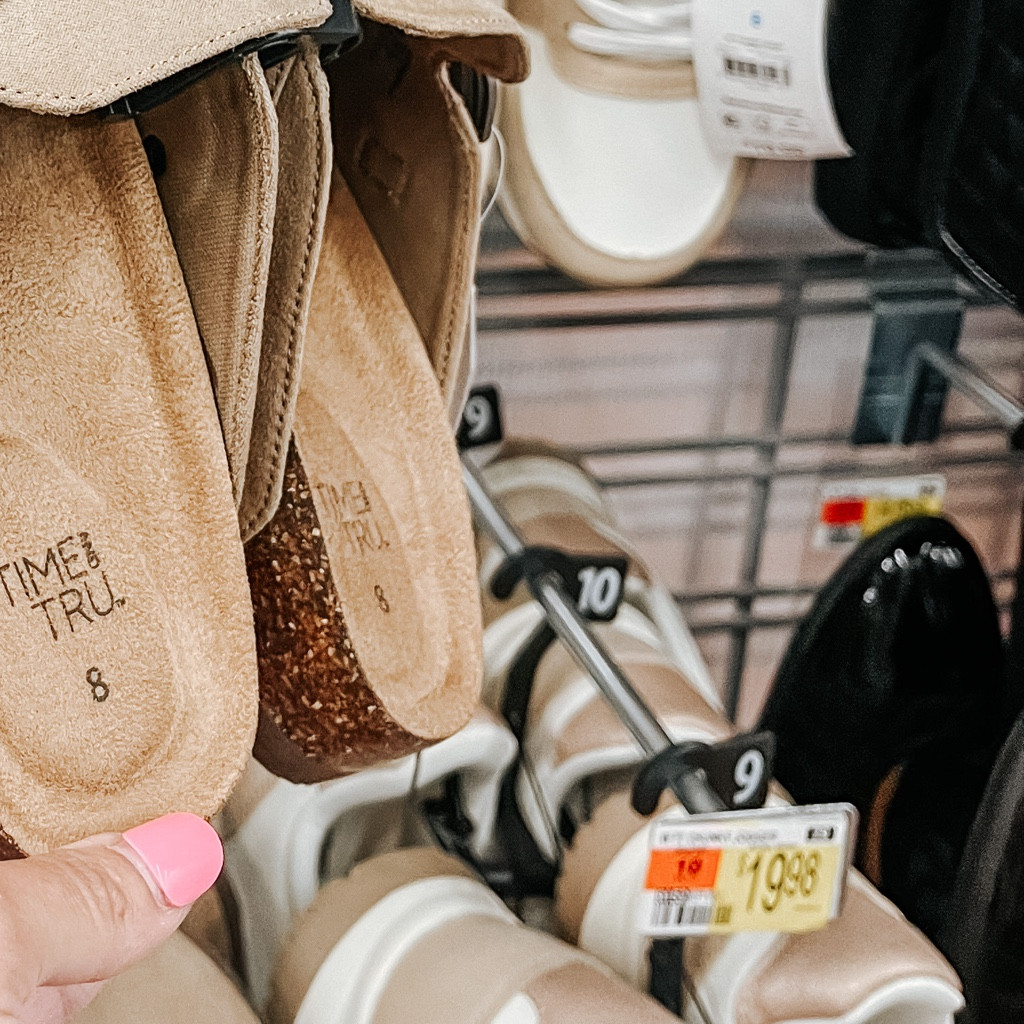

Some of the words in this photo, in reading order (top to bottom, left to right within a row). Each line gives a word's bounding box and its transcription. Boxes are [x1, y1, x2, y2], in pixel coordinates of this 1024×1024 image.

[463, 394, 492, 438] 9
[31, 570, 115, 641] TRU
[374, 584, 390, 613] 8
[577, 565, 624, 614] 10
[86, 666, 110, 703] 8
[733, 748, 766, 804] 9
